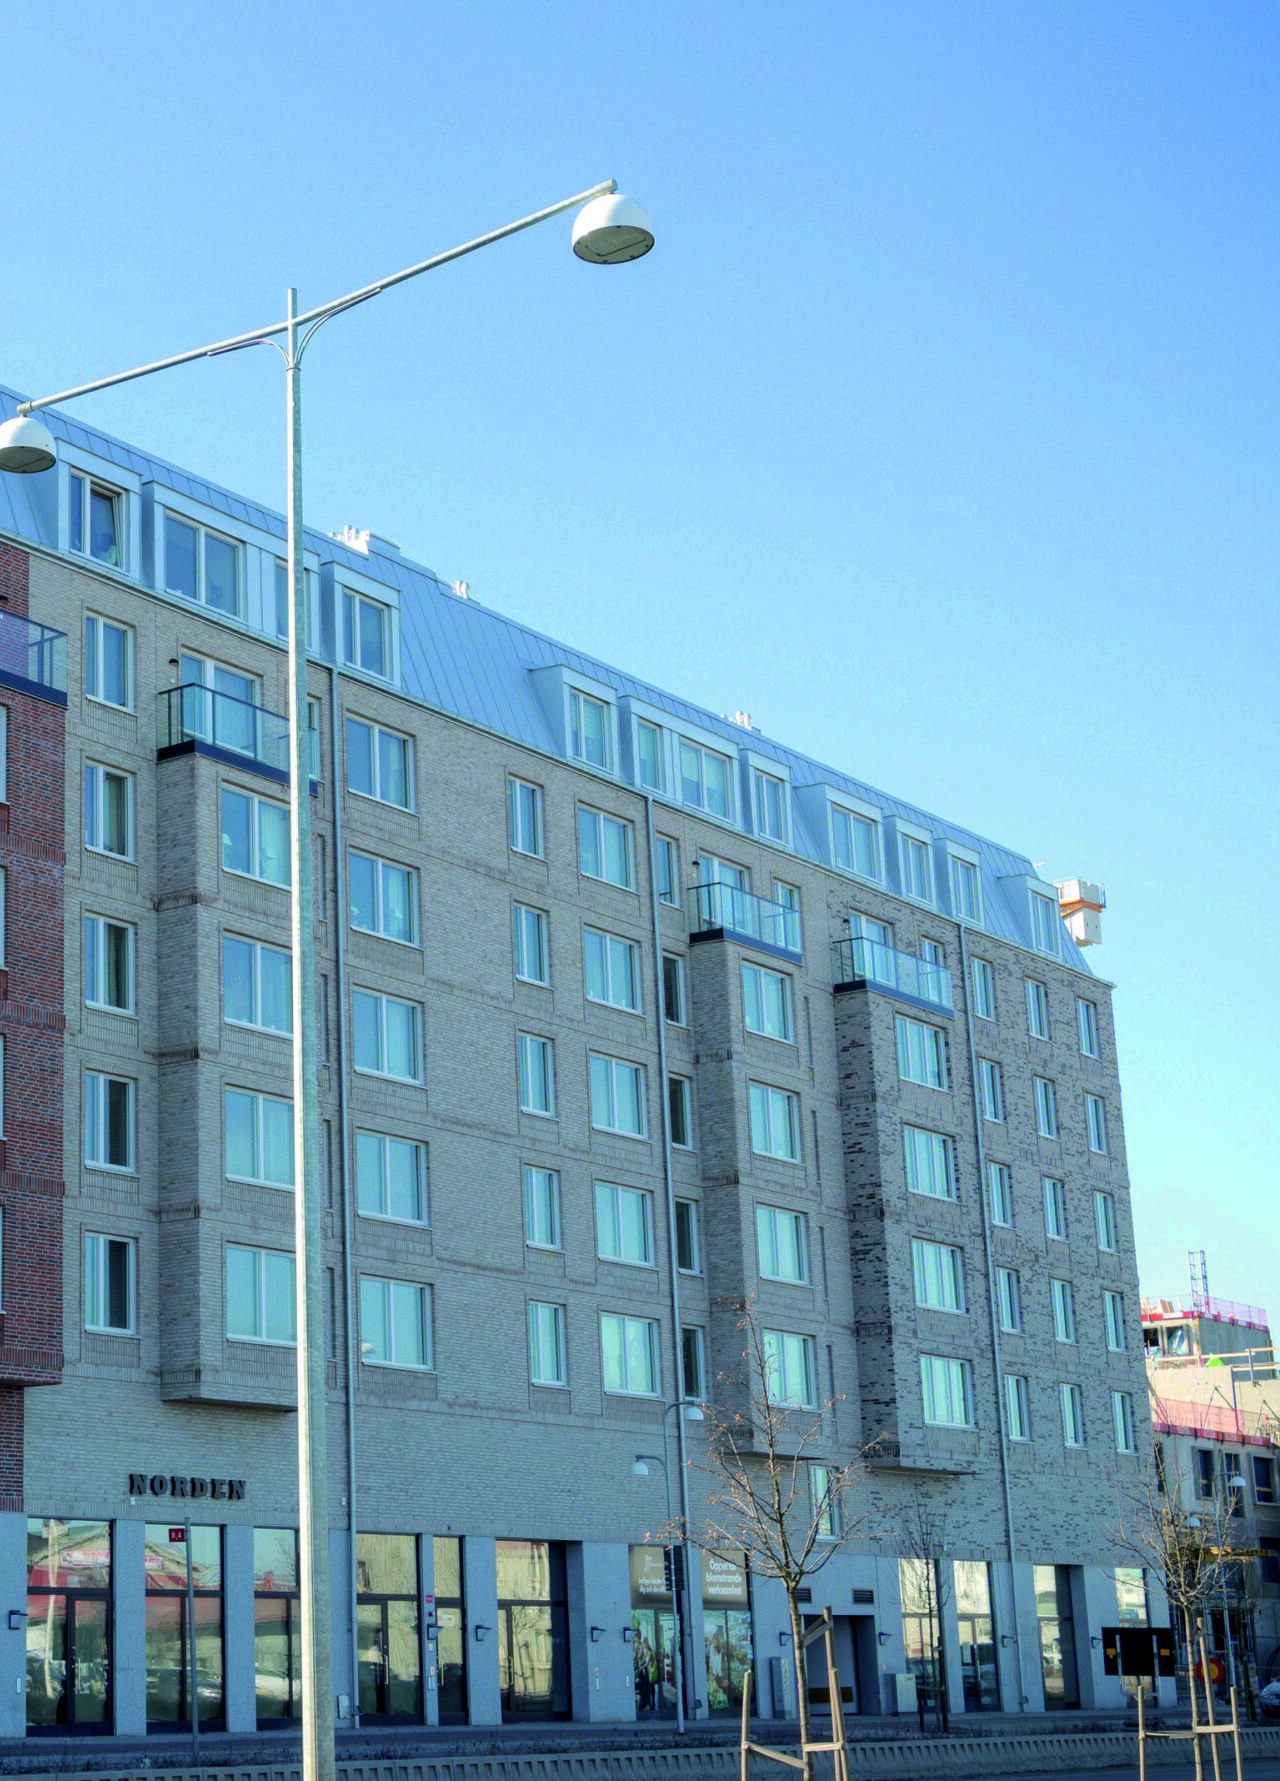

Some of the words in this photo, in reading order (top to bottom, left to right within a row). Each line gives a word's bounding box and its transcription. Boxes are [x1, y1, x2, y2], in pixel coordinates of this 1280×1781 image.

[129, 1474, 246, 1500] NORDEN
[171, 1531, 182, 1540] 8,4
[705, 1572, 743, 1583] blomstrande
[708, 1584, 742, 1595] verksamhet
